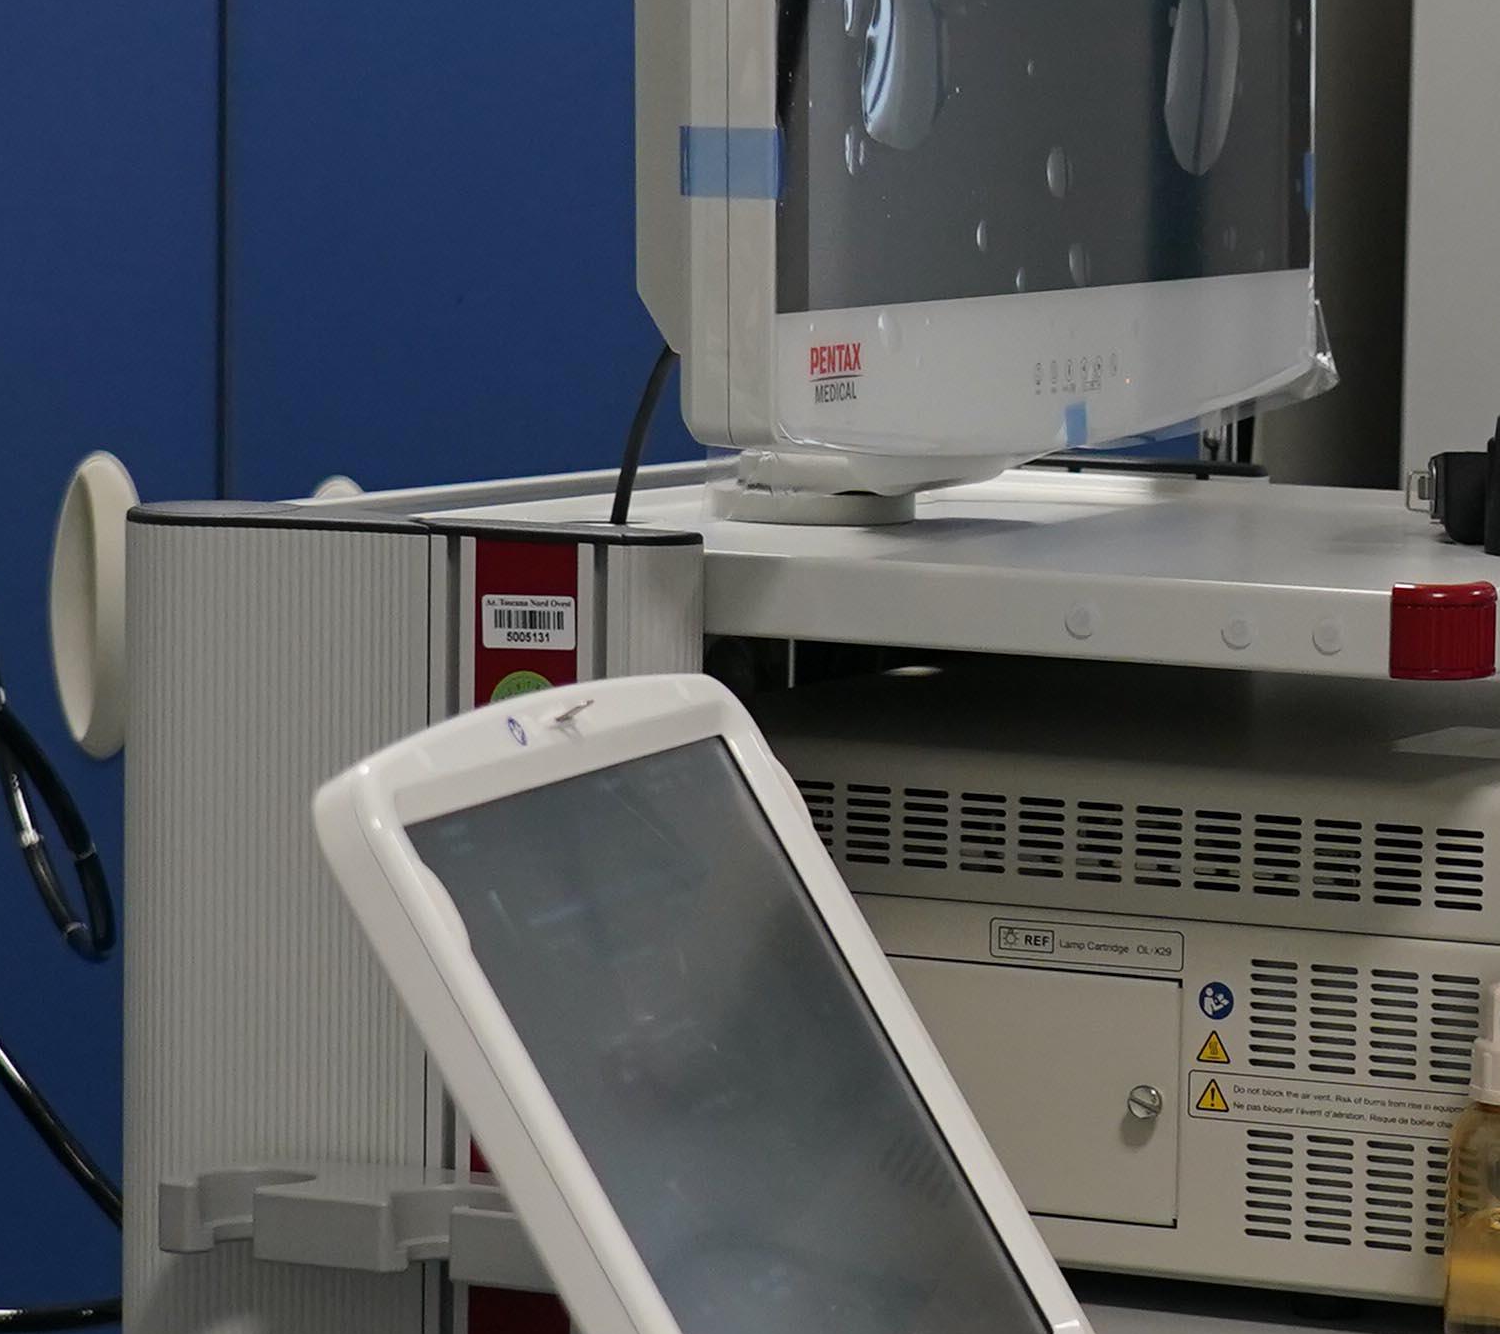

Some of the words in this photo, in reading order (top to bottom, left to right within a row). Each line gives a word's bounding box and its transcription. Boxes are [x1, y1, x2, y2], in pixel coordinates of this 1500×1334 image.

[810, 342, 861, 375] PENTAX
[815, 381, 857, 404] MEDICAL
[500, 598, 528, 606] Toscana
[530, 599, 549, 607] Nord
[551, 599, 571, 607] Ovest
[506, 631, 551, 643] 5005131
[1024, 934, 1050, 947] REF
[1059, 939, 1085, 951] Lamp
[1087, 940, 1129, 955] Cartridge
[1233, 1084, 1245, 1094] Do
[1247, 1086, 1260, 1095] not
[1262, 1087, 1284, 1098] block
[1286, 1090, 1299, 1099] the
[1301, 1092, 1311, 1100] air
[1335, 1094, 1352, 1103] Risk
[1354, 1097, 1363, 1105] of
[1363, 1097, 1386, 1107] burns
[1387, 1099, 1406, 1108] from
[1233, 1101, 1244, 1110] Ne
[1246, 1103, 1261, 1113] pas
[1263, 1104, 1293, 1115] bloquer
[1369, 1113, 1396, 1124] Risque
[1398, 1116, 1409, 1125] de
